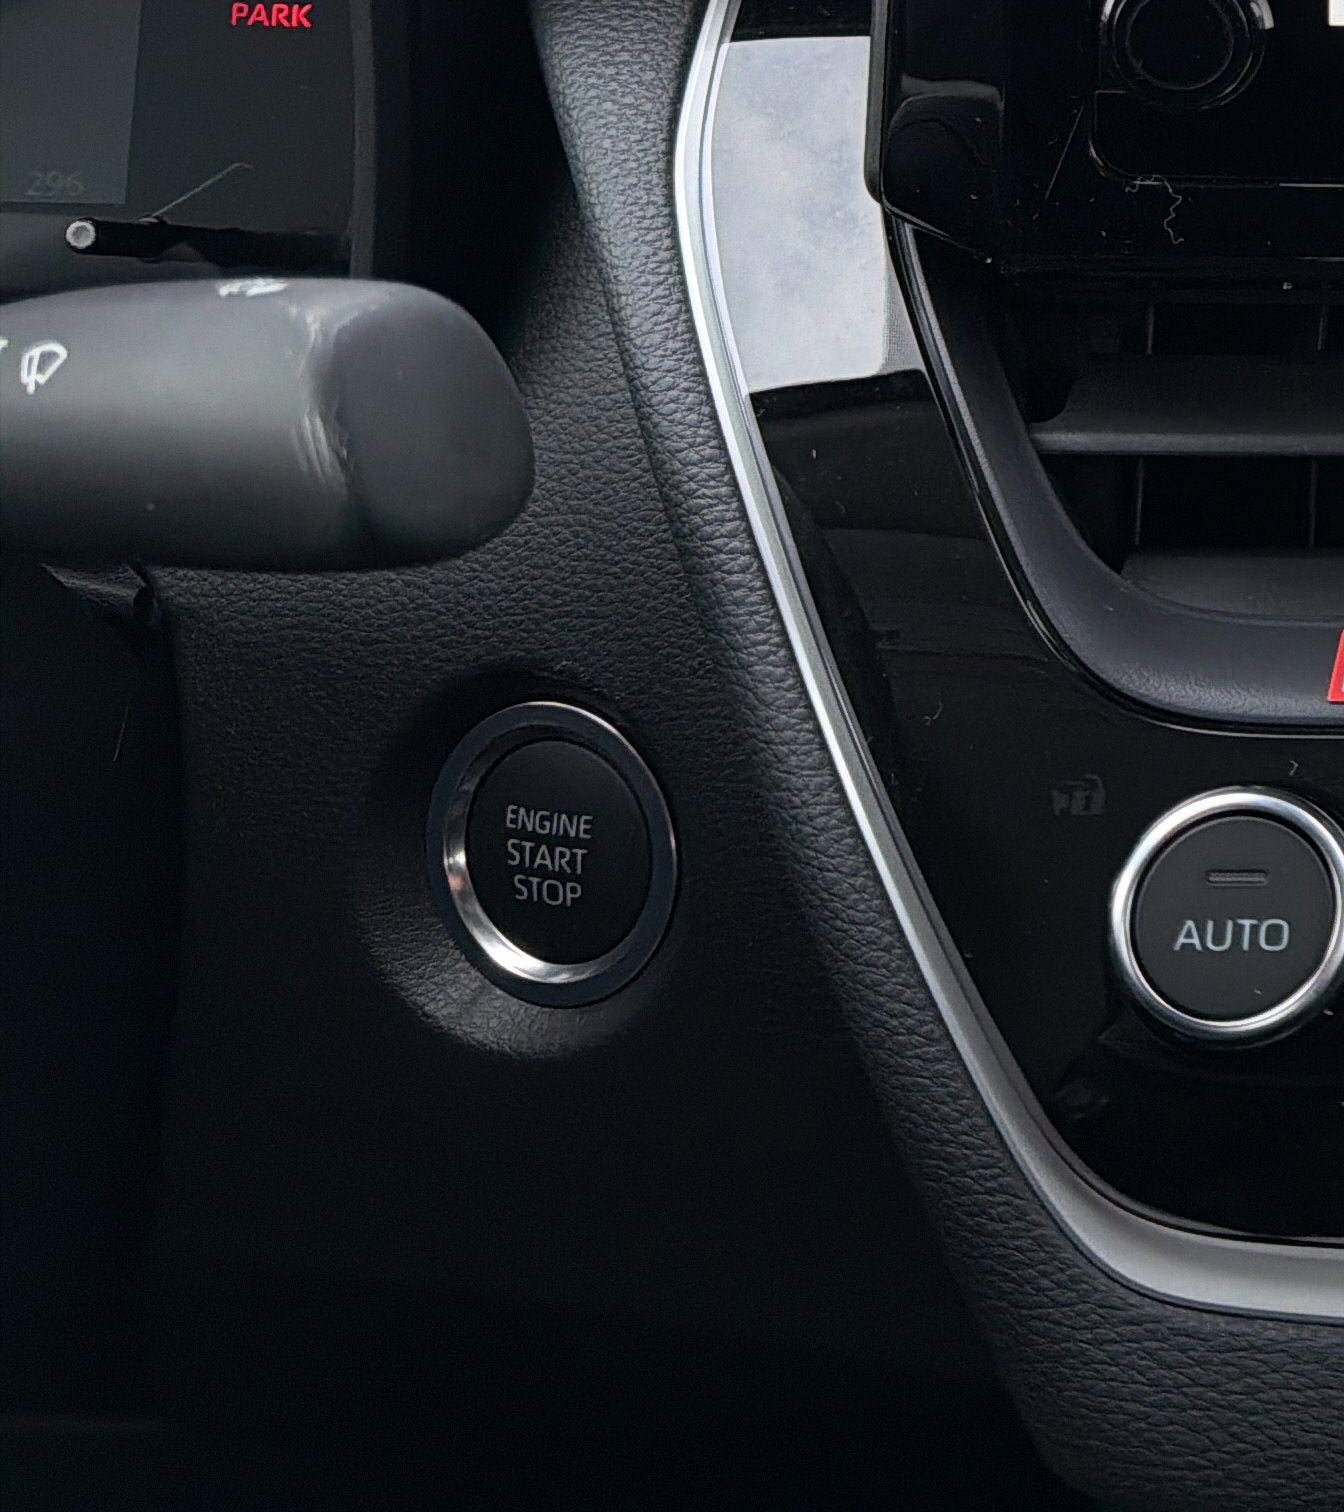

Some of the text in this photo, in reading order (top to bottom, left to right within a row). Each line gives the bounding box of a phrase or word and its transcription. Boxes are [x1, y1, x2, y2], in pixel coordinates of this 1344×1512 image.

[230, 1, 313, 29] PARK
[506, 805, 592, 839] ENGINE
[507, 839, 588, 874] START
[515, 875, 582, 907] STOP
[1173, 918, 1290, 953] AUTO
